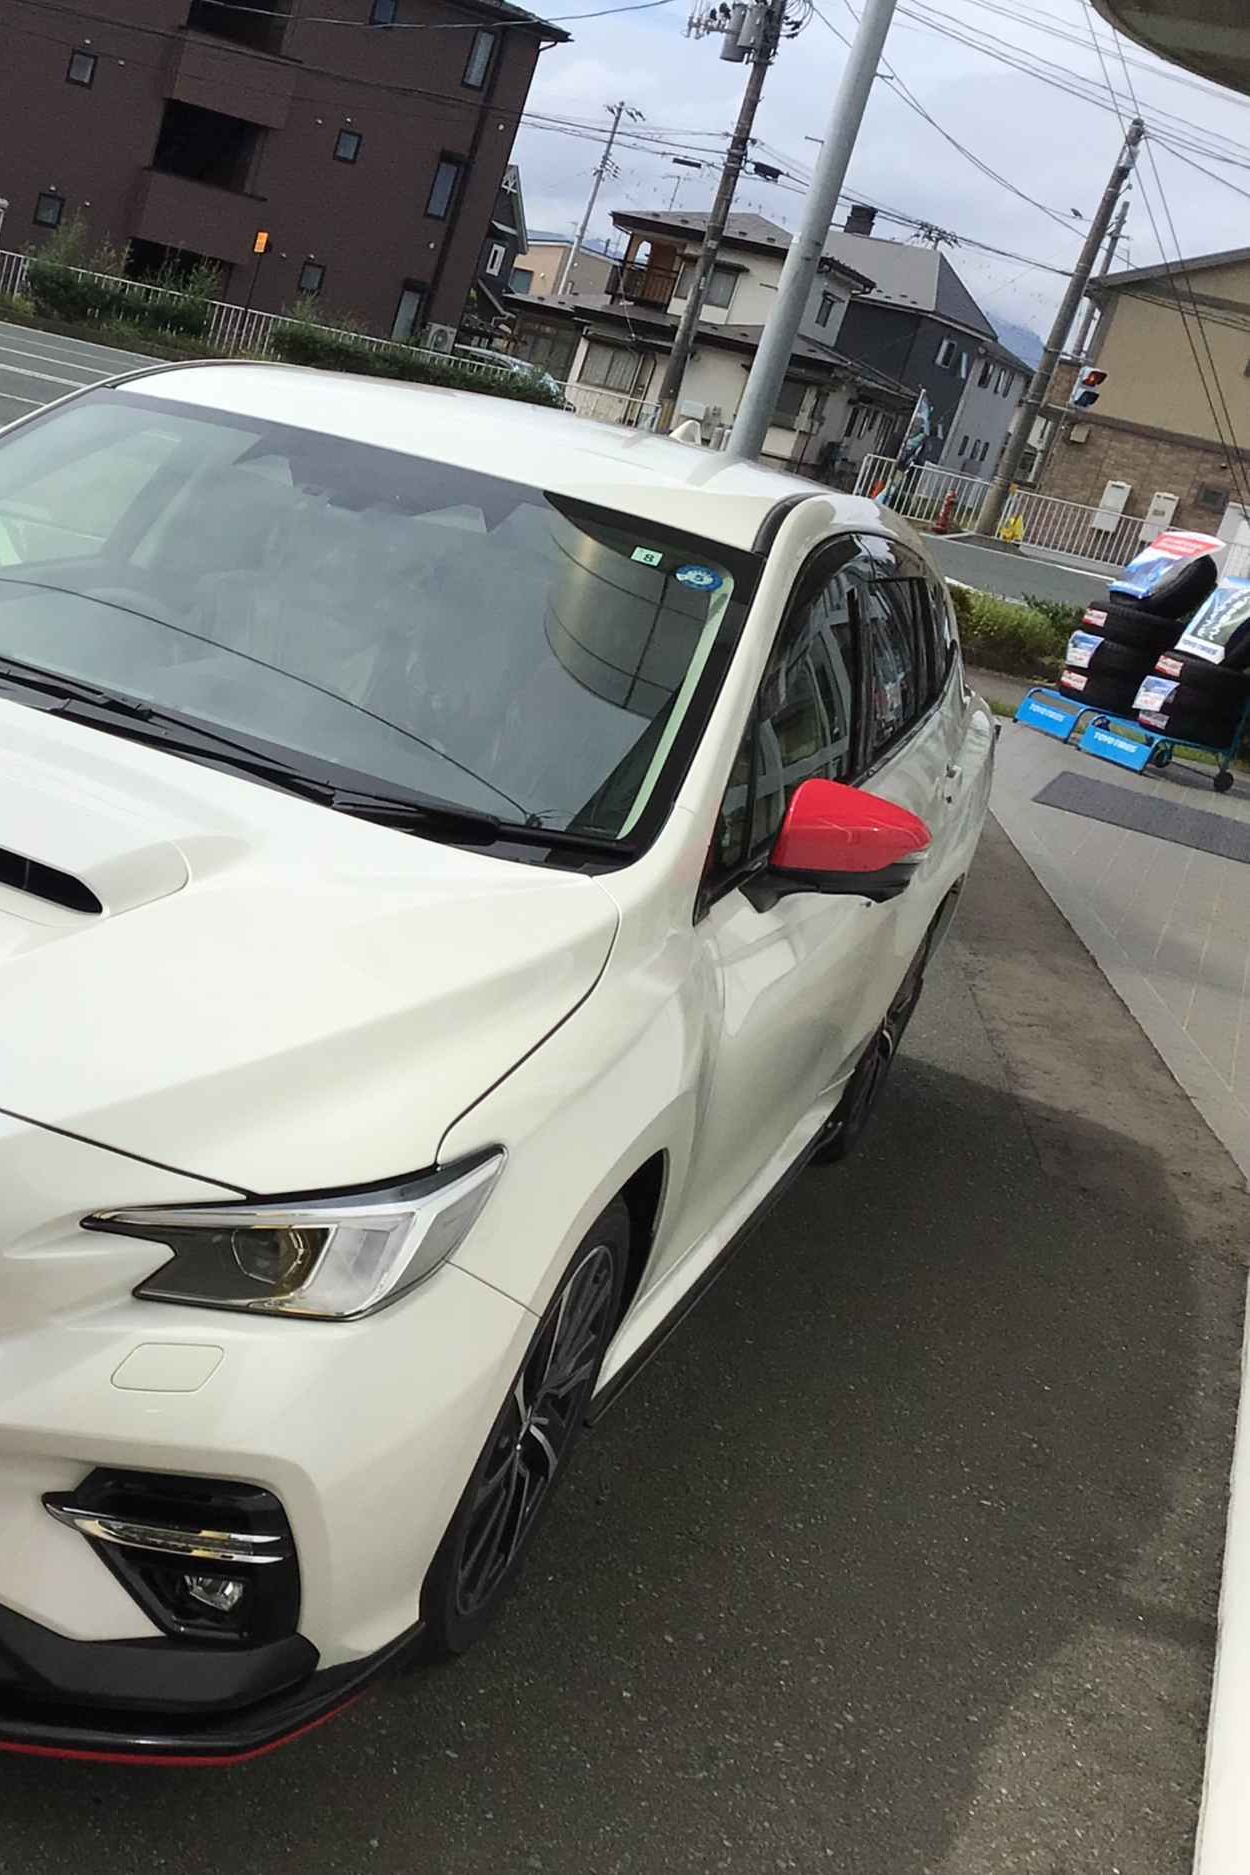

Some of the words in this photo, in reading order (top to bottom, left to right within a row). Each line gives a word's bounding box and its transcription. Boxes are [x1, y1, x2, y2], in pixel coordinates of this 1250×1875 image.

[643, 554, 654, 562] 8
[1029, 703, 1046, 715] TOYO
[1046, 709, 1065, 722] TIRES
[1093, 732, 1114, 744] TOYO
[1113, 739, 1138, 753] TIRES
